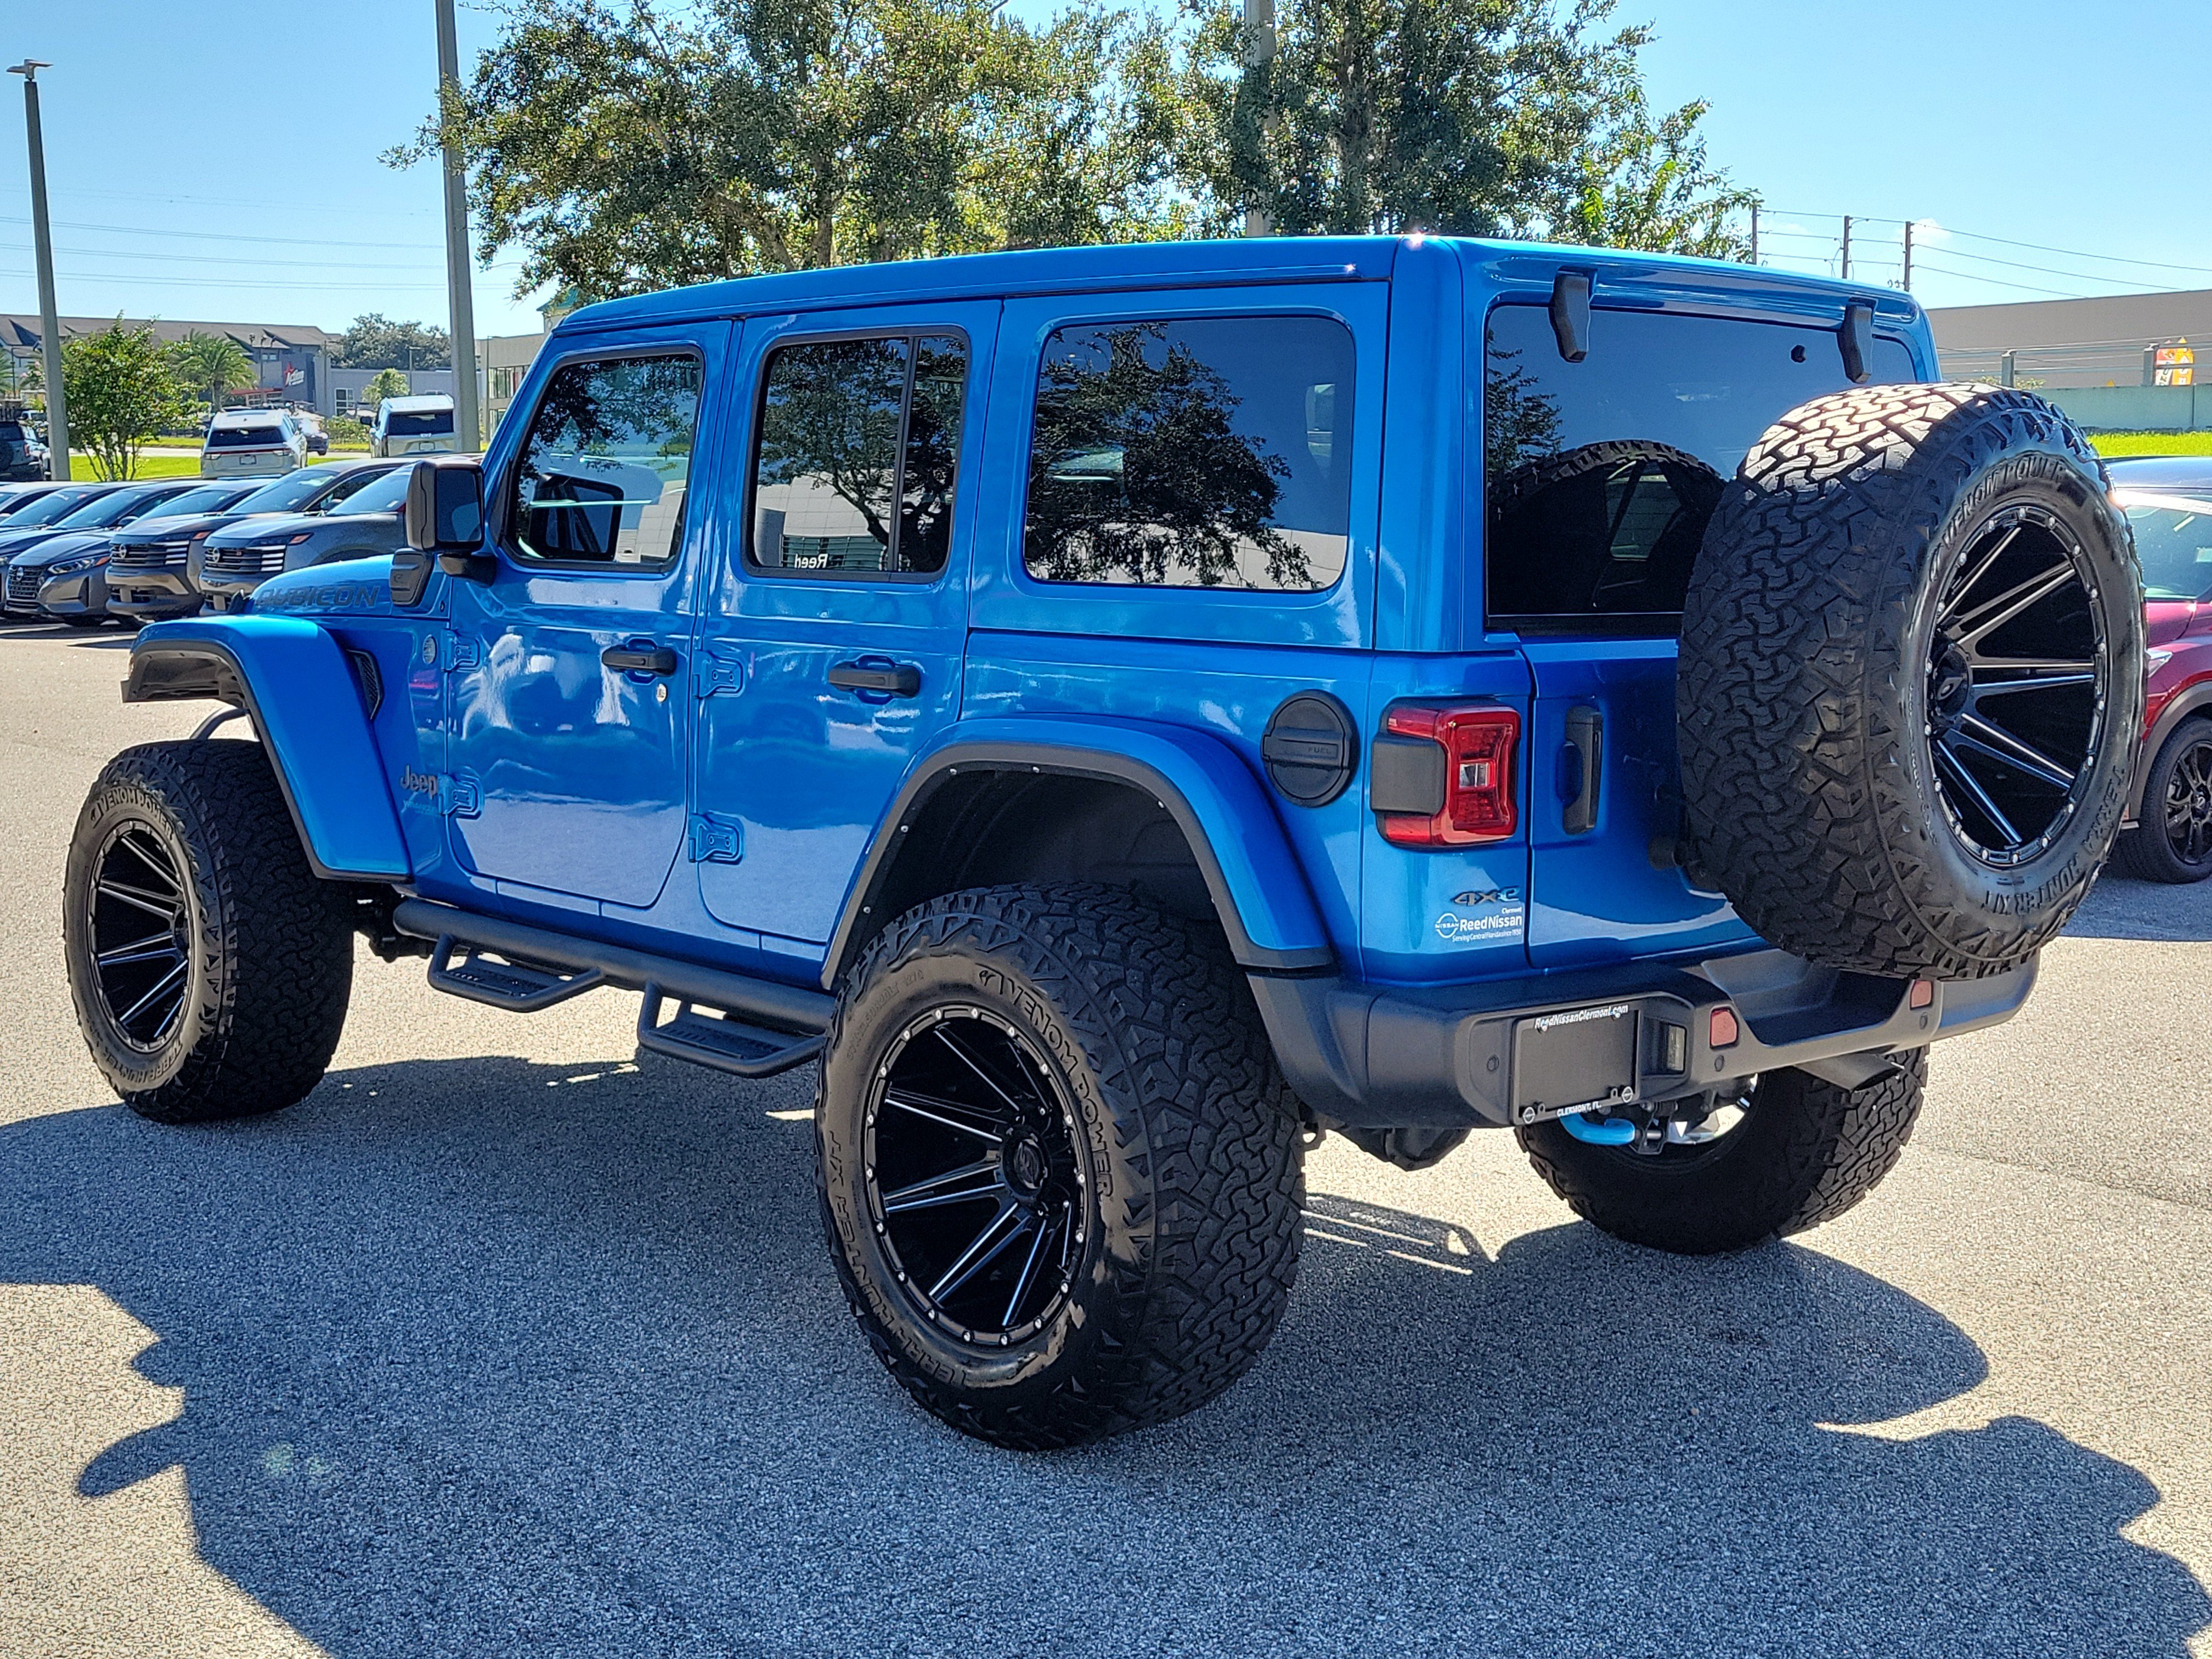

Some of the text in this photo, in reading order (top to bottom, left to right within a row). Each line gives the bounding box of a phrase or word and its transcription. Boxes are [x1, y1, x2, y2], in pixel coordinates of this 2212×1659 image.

[255, 585, 381, 608] RUBICON
[400, 764, 438, 800] Jeep
[1006, 978, 1114, 1202] VENOM POWER
